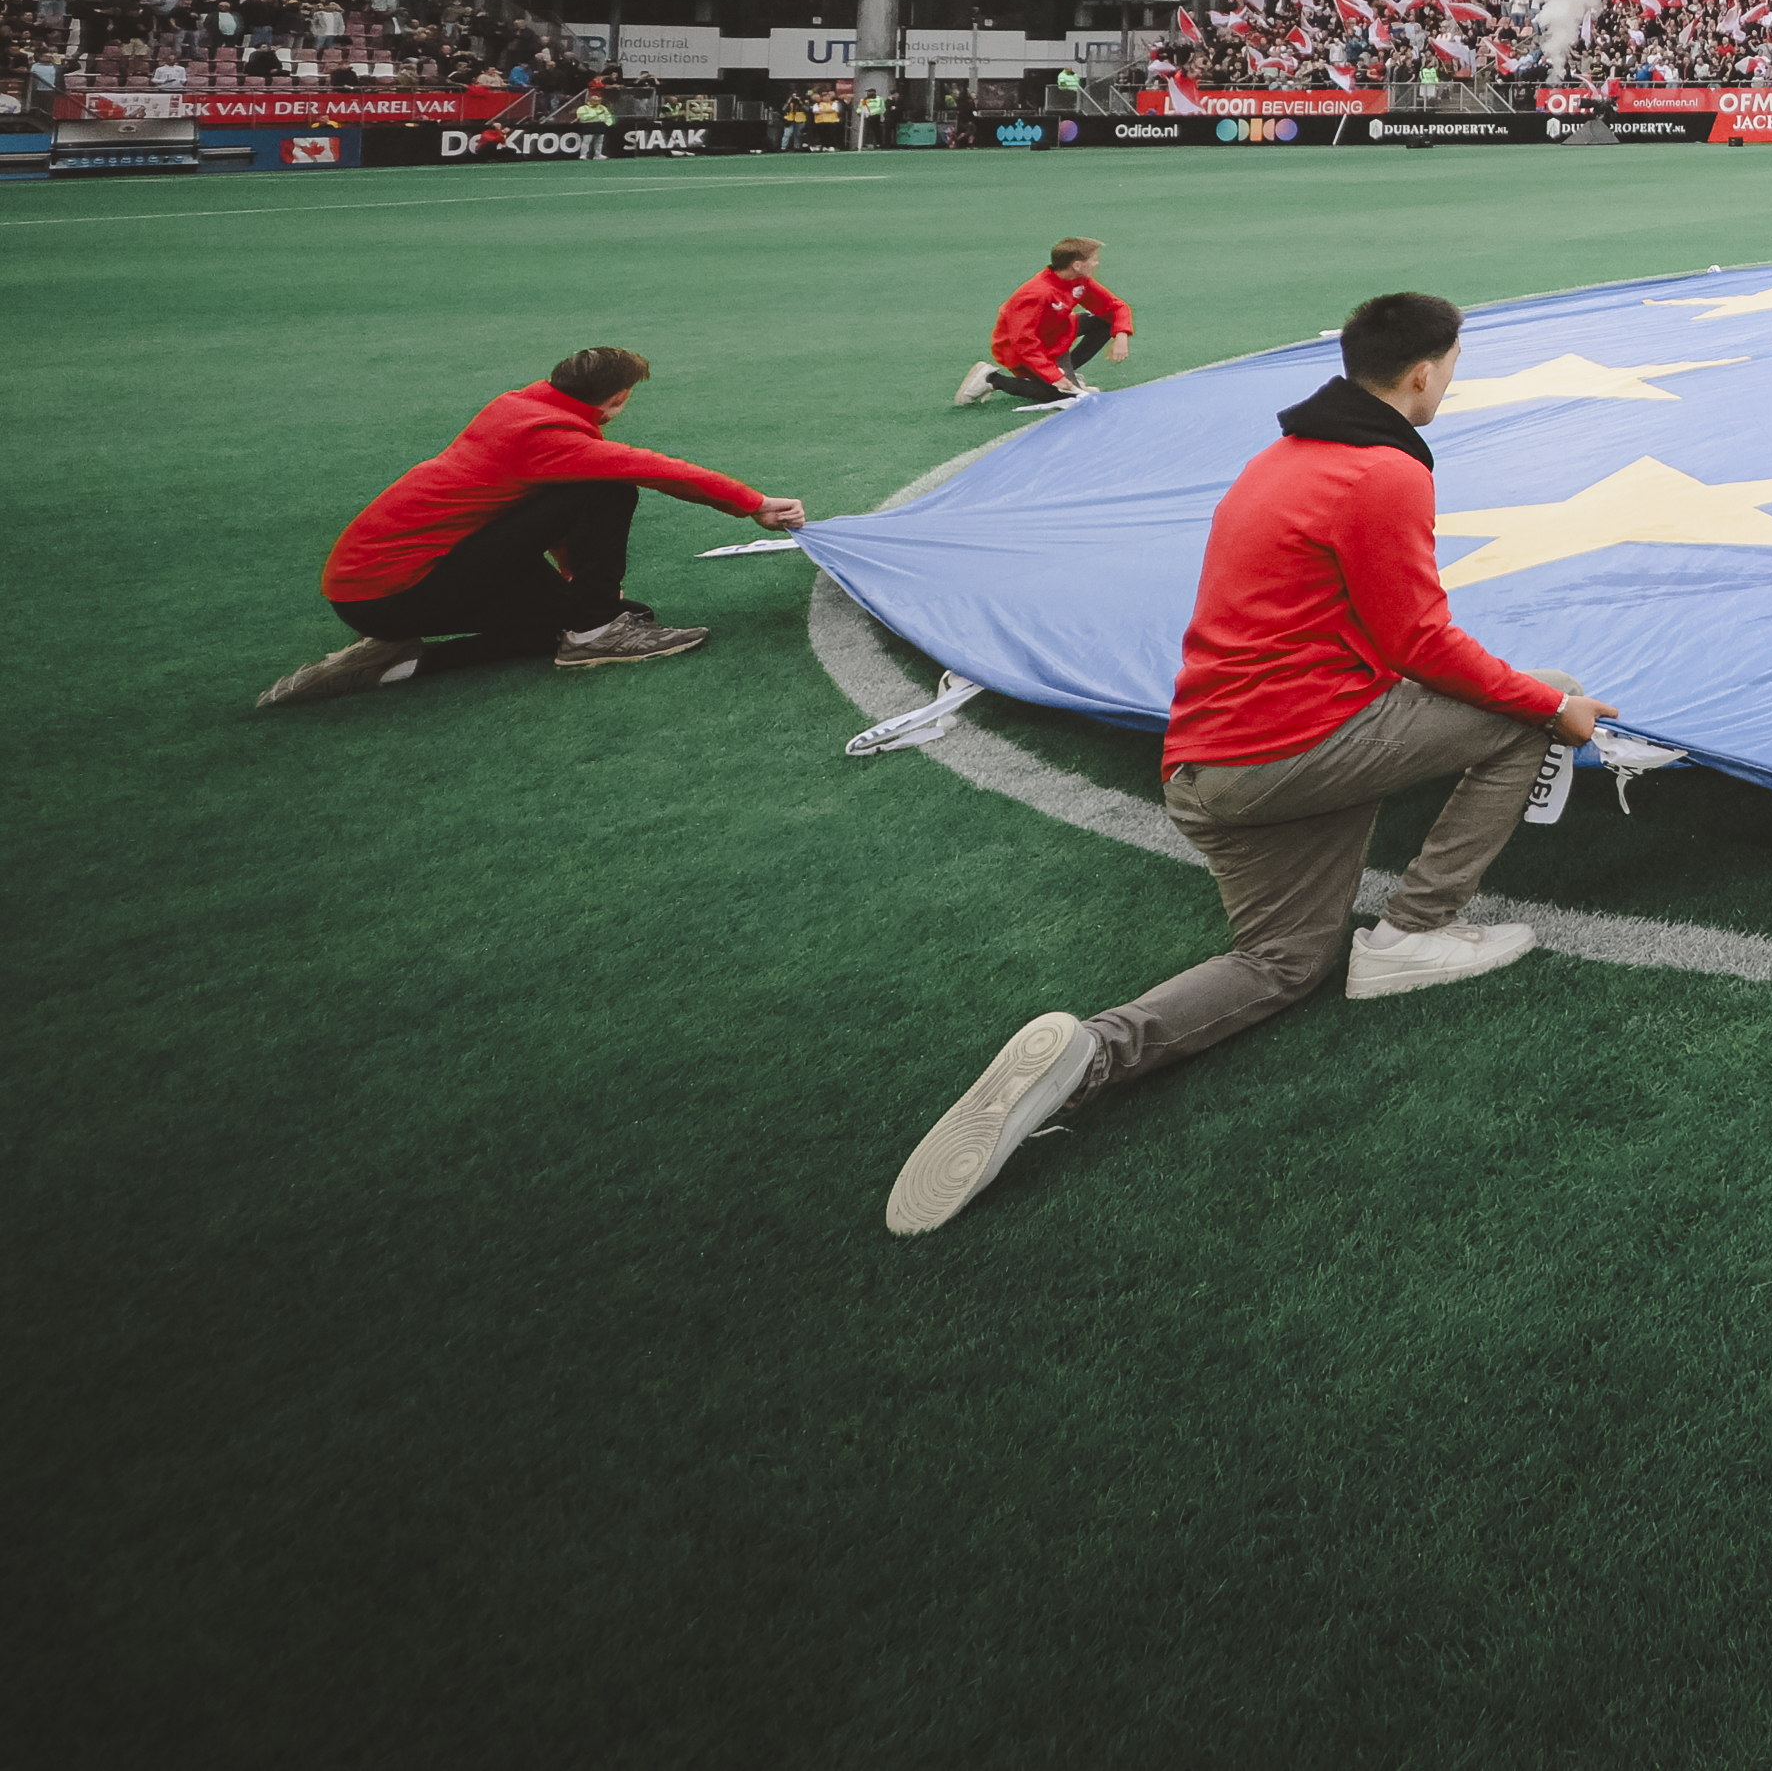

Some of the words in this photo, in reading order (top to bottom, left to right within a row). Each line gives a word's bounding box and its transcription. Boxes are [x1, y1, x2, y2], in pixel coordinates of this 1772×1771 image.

[619, 36, 689, 49] Industrial
[807, 39, 858, 64] UT
[619, 52, 709, 65] Acquisitions
[215, 101, 266, 116] VAN
[273, 101, 319, 116] DER
[325, 100, 412, 115] MAAREL
[415, 99, 457, 114] VAK
[1261, 100, 1363, 115] BEVEILIGING
[1633, 98, 1699, 109] onlyformen.nl
[1115, 124, 1178, 138] Odido.nl
[1383, 124, 1509, 135] DUBAI-PROPERTY.NL
